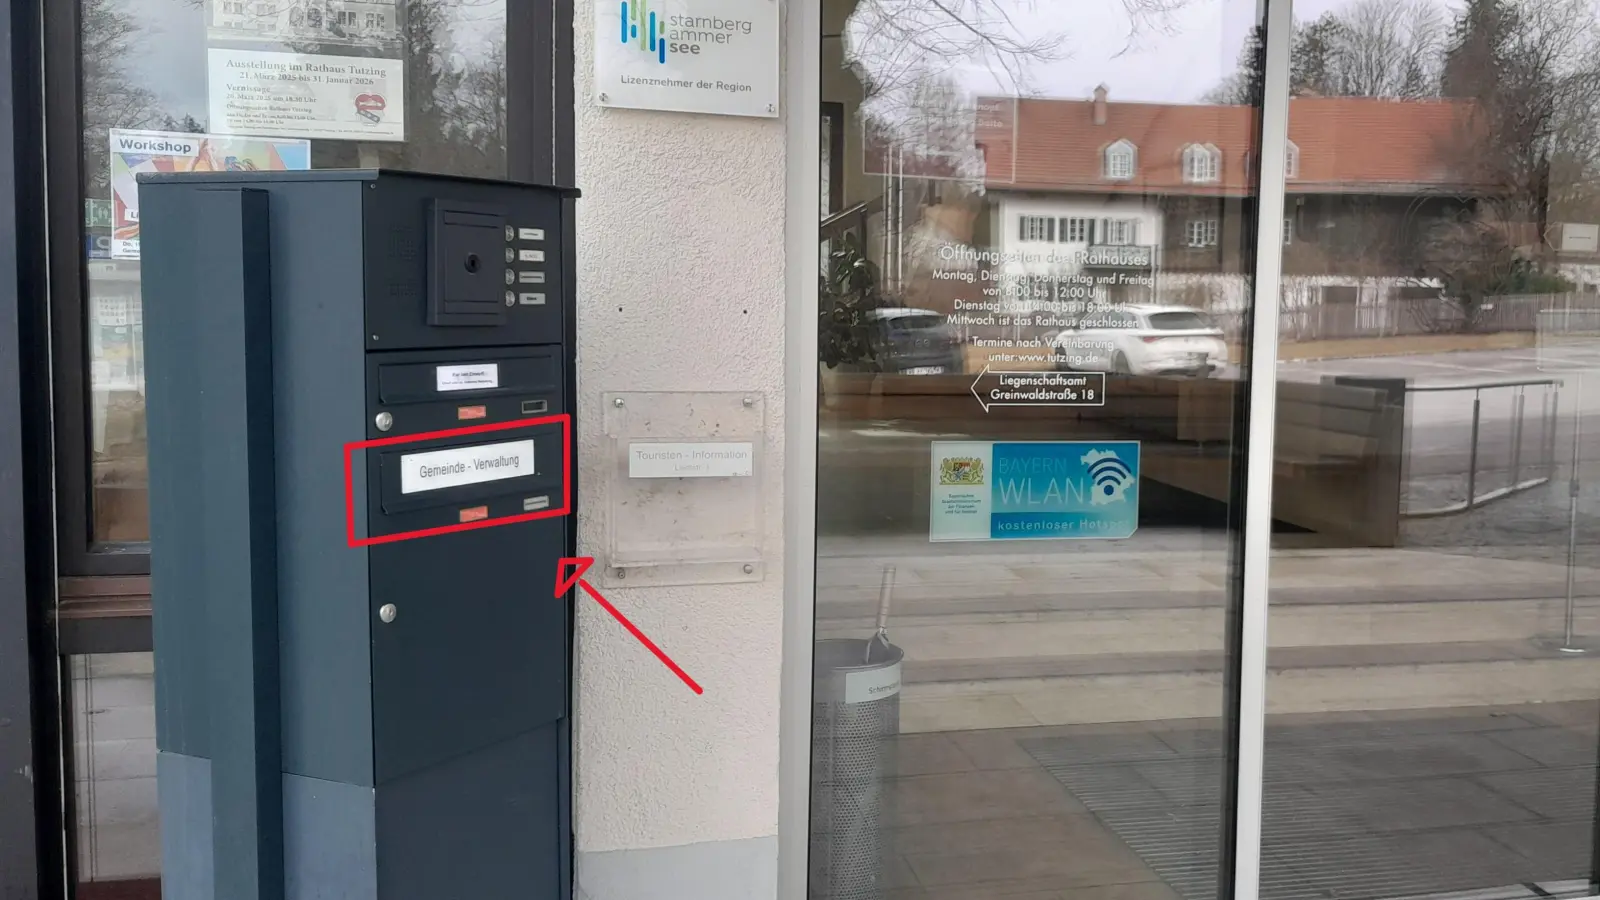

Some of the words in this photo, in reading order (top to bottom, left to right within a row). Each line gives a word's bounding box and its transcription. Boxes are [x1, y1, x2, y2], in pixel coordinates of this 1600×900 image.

[670, 14, 752, 34] starnberg
[669, 29, 733, 44] ammer
[669, 43, 701, 55] see
[226, 60, 286, 72] Ausstellung
[289, 62, 302, 71] im
[306, 63, 345, 73] Rathaus
[348, 65, 386, 78] Tutzing
[278, 73, 297, 81] 2025
[299, 74, 311, 82] bis
[326, 75, 353, 84] Januar
[355, 77, 374, 85] 2026
[620, 75, 693, 88] Lizenznehmer
[696, 79, 714, 90] der
[716, 81, 752, 92] Region
[226, 83, 271, 95] Vernissage
[119, 138, 192, 154] Workshop
[1080, 250, 1148, 266] Rathauses
[932, 269, 977, 283] Montag,
[1034, 273, 1093, 287] Donnerstag
[1096, 272, 1116, 284] und
[1119, 274, 1154, 287] Freitag
[983, 287, 1001, 297] von
[1034, 286, 1049, 298] bis
[954, 299, 1000, 314] Dienstag
[947, 314, 995, 326] Mittwoch
[998, 315, 1010, 326] ist
[1013, 315, 1032, 327] das
[1036, 315, 1077, 328] Rathaus
[1079, 316, 1139, 330] geschlossen
[972, 336, 1014, 348] Termine
[1016, 336, 1042, 348] nach
[1044, 337, 1114, 351] Vereinbarung
[1000, 374, 1087, 390] Liegenschaftsamt
[990, 388, 1077, 401] Greinwaldstraße
[1081, 389, 1095, 400] 18
[636, 450, 683, 461] Touristen
[692, 450, 748, 461] Information
[419, 462, 466, 479] Gemeinde
[473, 455, 520, 471] Verwaltung
[999, 457, 1067, 475] BAYERN
[998, 476, 1084, 505] WLAN
[998, 520, 1074, 531] kostenloser
